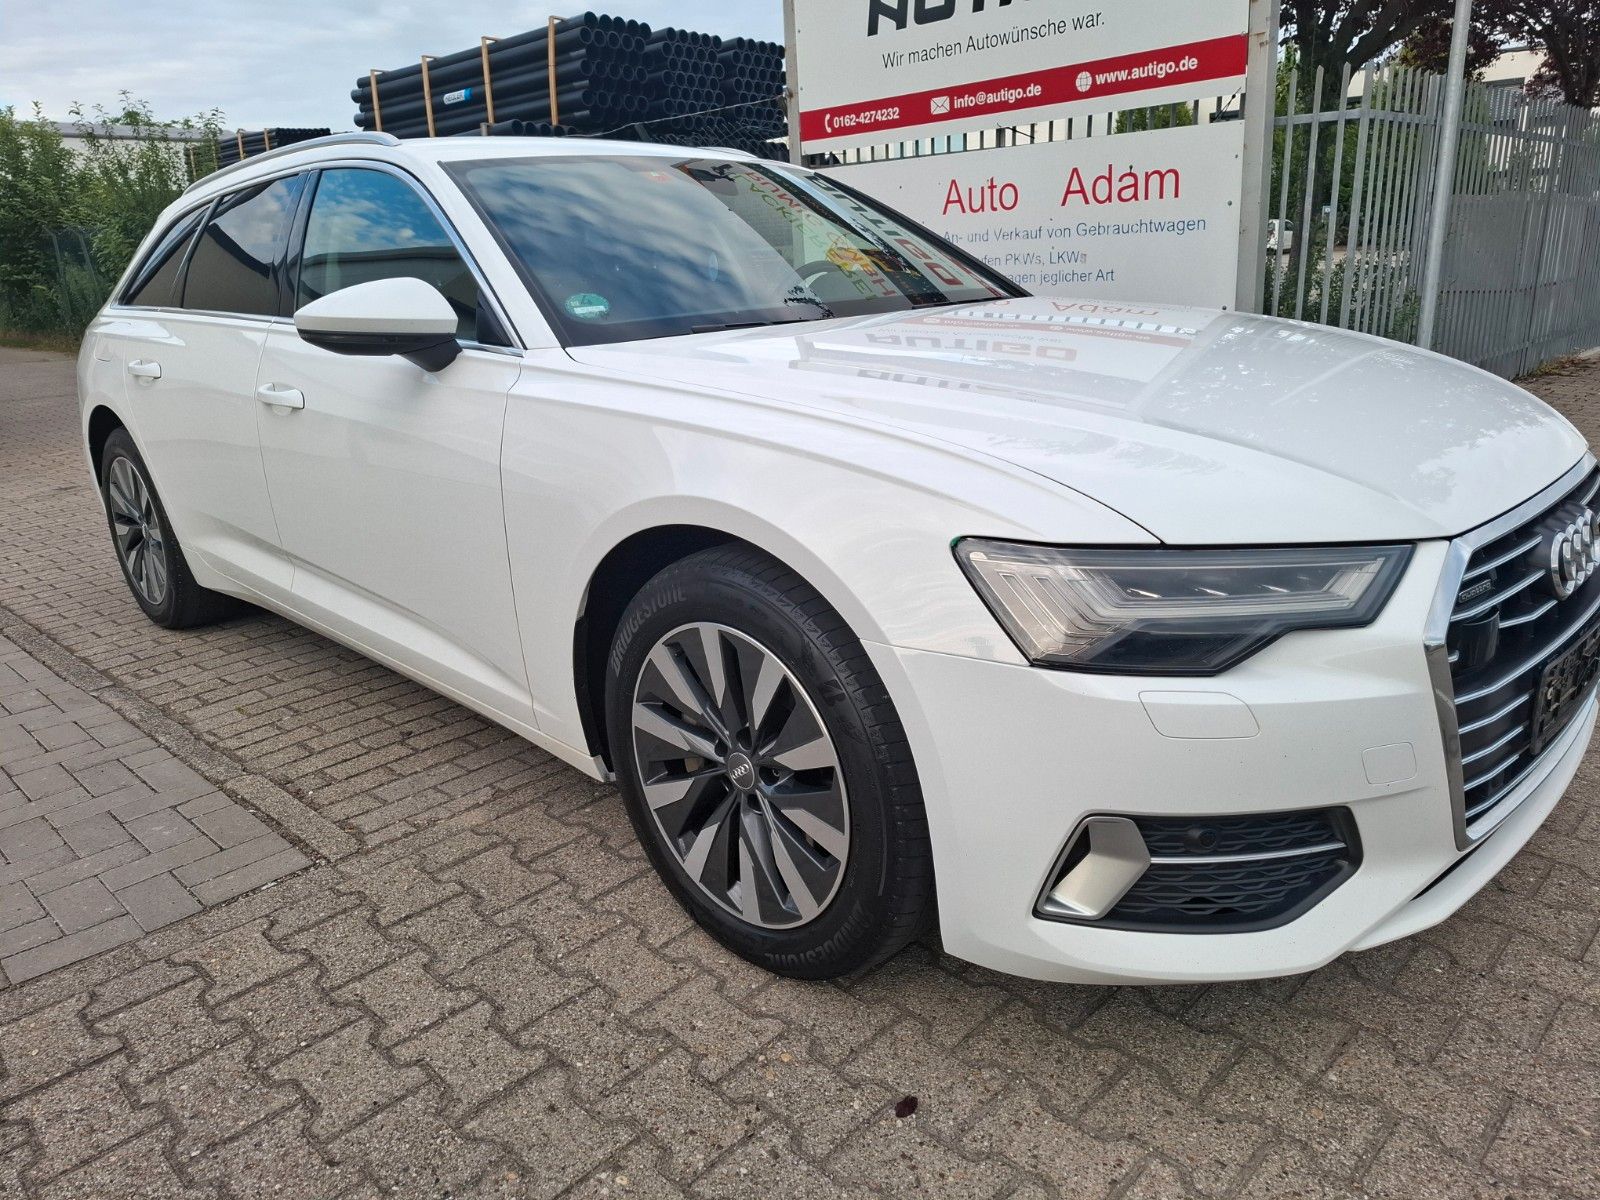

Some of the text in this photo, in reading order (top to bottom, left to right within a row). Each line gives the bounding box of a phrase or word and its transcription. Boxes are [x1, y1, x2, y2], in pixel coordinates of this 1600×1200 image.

[882, 51, 904, 69] Wir
[907, 40, 962, 64] machen
[965, 18, 1067, 53] Autowünsche
[1071, 11, 1106, 31] war.
[833, 56, 1198, 129] 0162-4274232 info@autigo.de www.autigo.de
[942, 163, 1181, 216] Auto Adam
[944, 217, 1207, 244] An- und Verkauf von Gebrauchtwagen
[1004, 252, 1045, 267] PKWs,
[1039, 268, 1092, 286] jeglicher
[1095, 268, 1115, 283] Art
